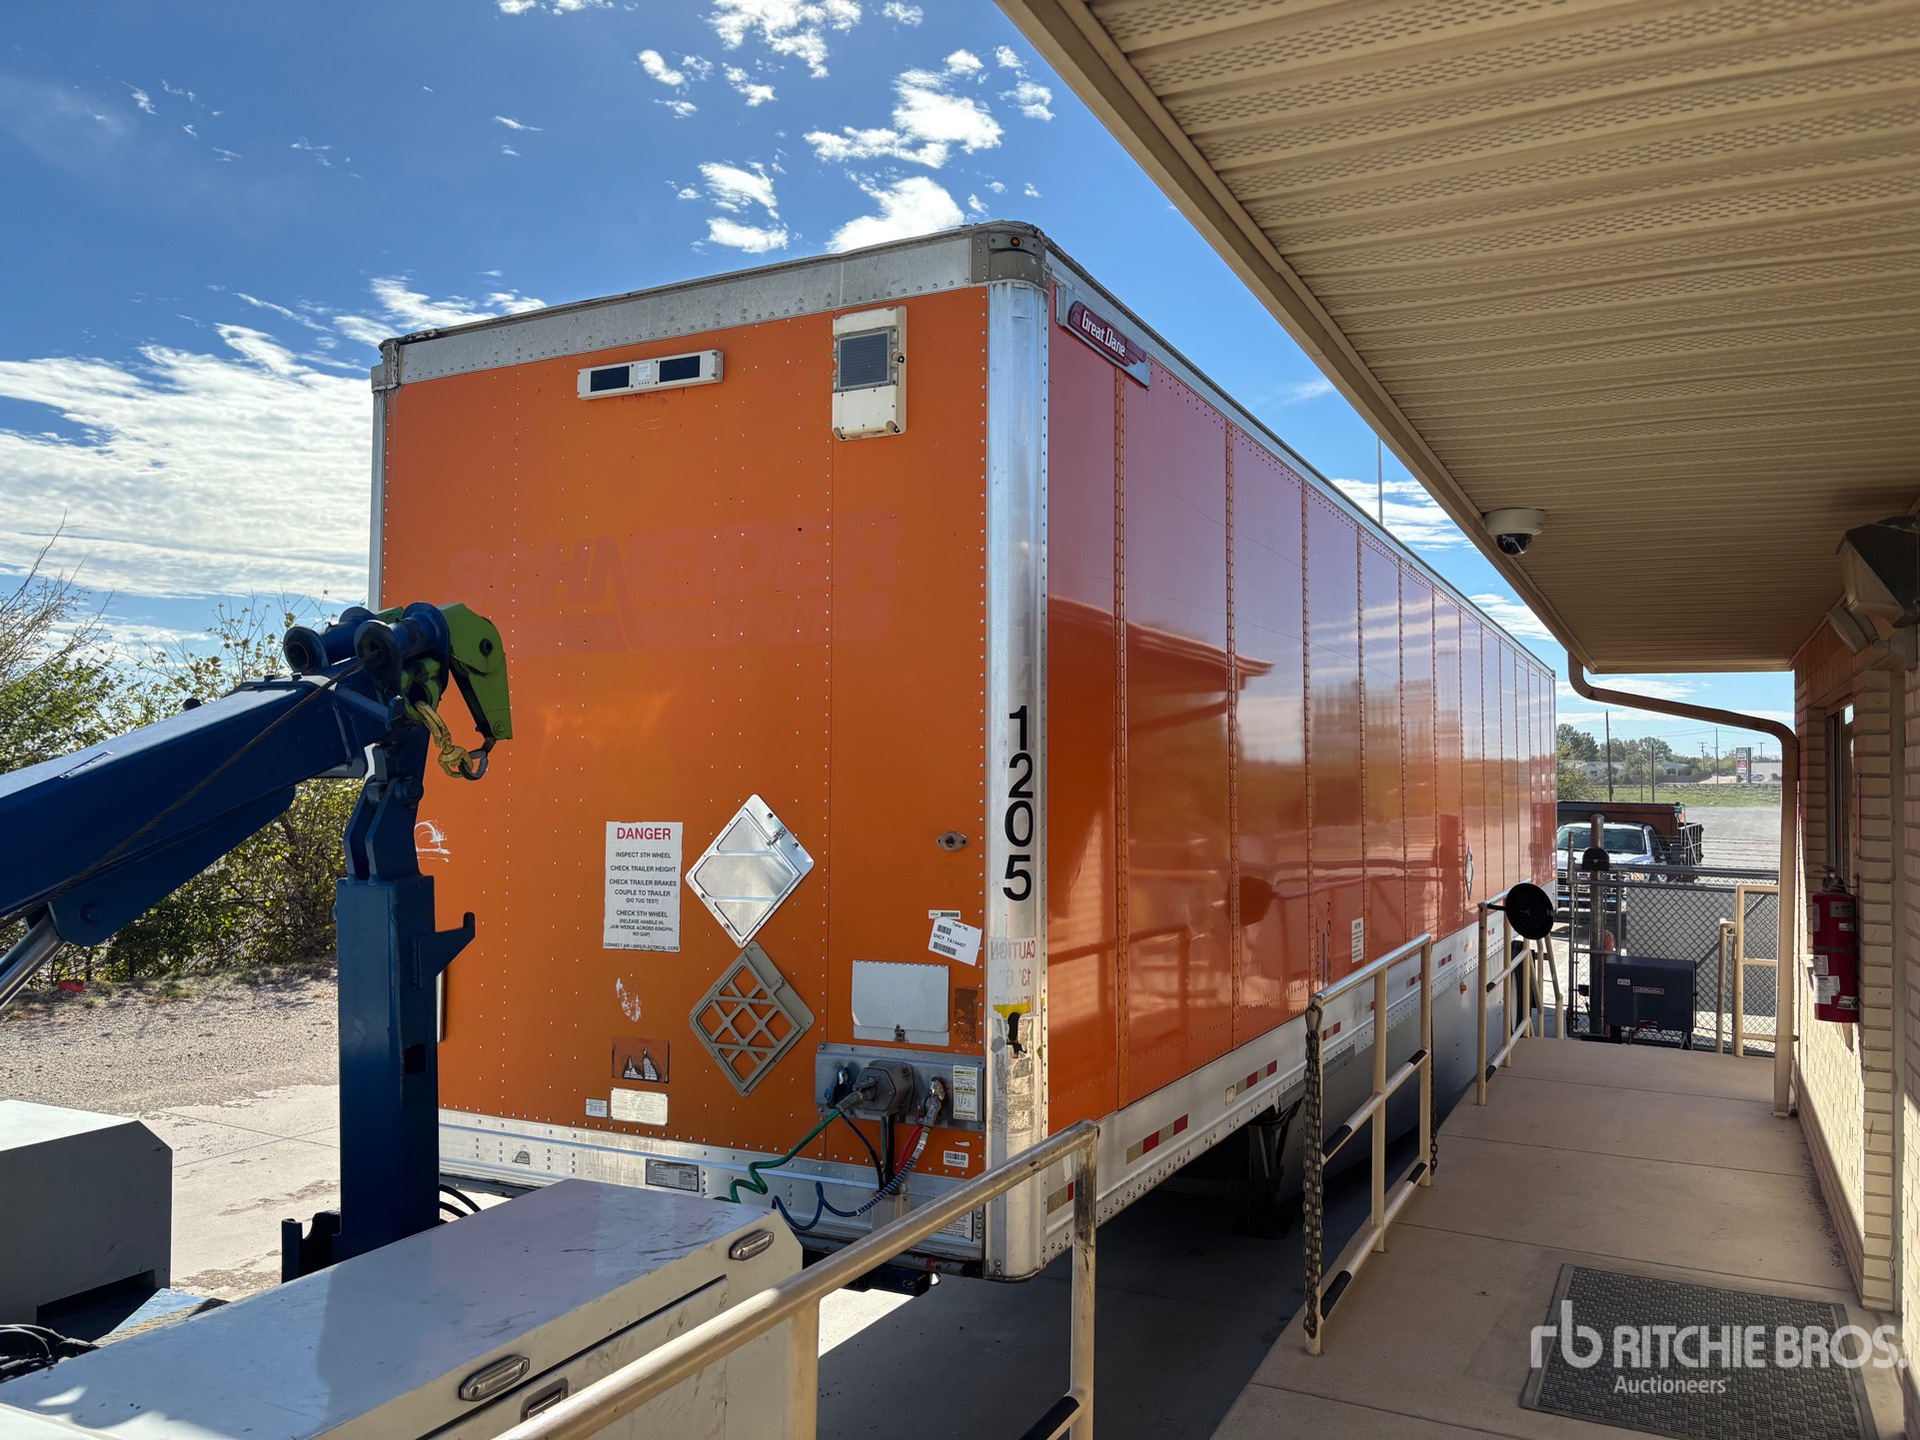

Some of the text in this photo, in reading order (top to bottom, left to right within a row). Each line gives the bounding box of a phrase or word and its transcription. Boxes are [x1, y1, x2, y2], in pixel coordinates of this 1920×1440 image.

[1081, 310, 1126, 358] Great Dane
[1003, 705, 1033, 901] 1205
[617, 827, 671, 840] DANGER
